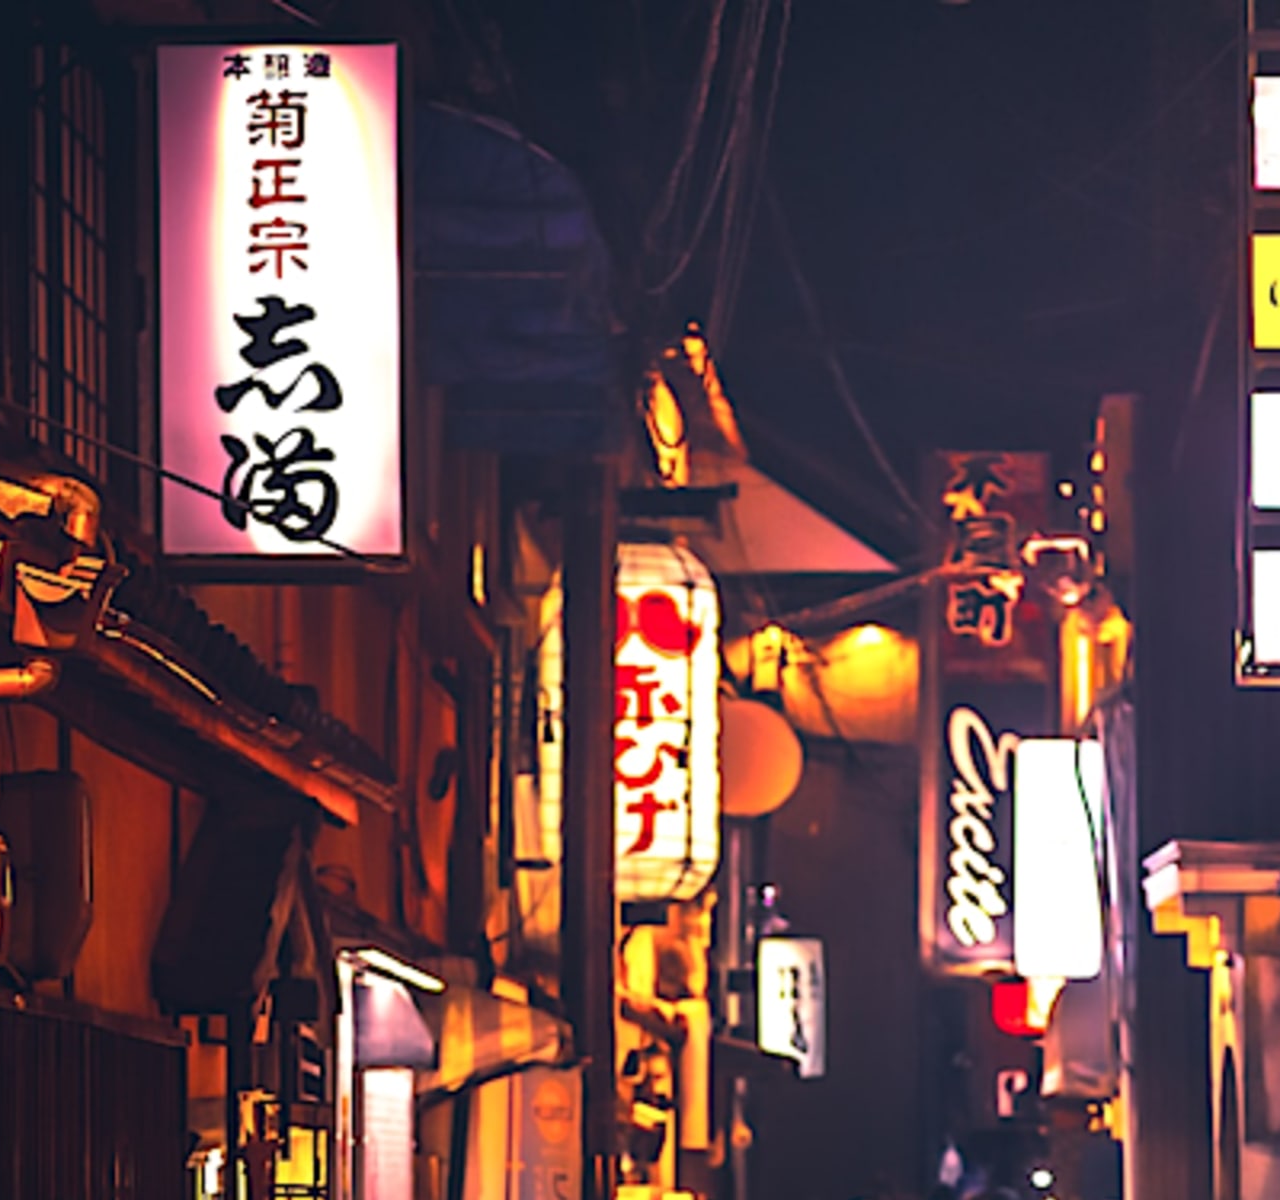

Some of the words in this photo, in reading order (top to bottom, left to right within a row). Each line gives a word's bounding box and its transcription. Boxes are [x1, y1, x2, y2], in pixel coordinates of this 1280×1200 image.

[246, 87, 310, 279] 菊正宗
[946, 705, 1019, 947] Excite
